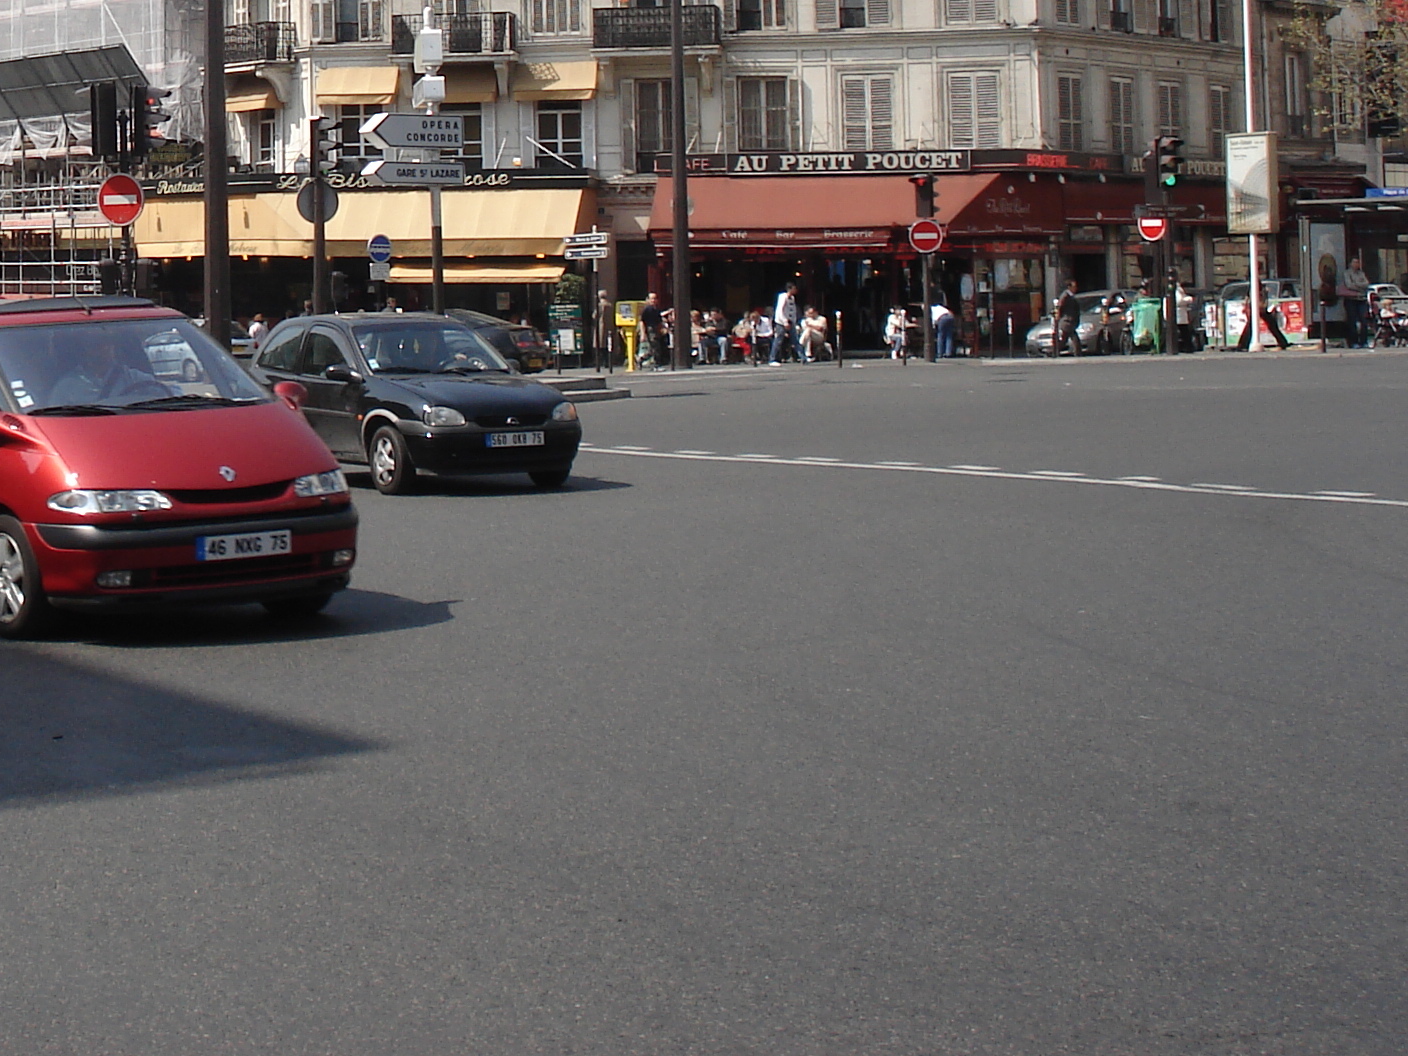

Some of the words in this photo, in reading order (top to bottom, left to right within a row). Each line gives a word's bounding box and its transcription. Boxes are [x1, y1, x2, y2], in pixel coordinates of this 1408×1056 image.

[406, 133, 460, 143] CONCORDE
[734, 155, 769, 172] AU
[779, 154, 855, 171] PETIT
[865, 152, 962, 170] POUCET
[1026, 153, 1068, 168] BRASSERIE
[396, 168, 417, 178] GARE
[430, 169, 461, 179] LAZARE
[775, 230, 794, 238] Bar
[824, 229, 873, 239] Brasserie
[532, 432, 542, 444] 75
[208, 538, 227, 556] 46
[234, 536, 262, 554] NXG
[270, 534, 288, 551] 75
